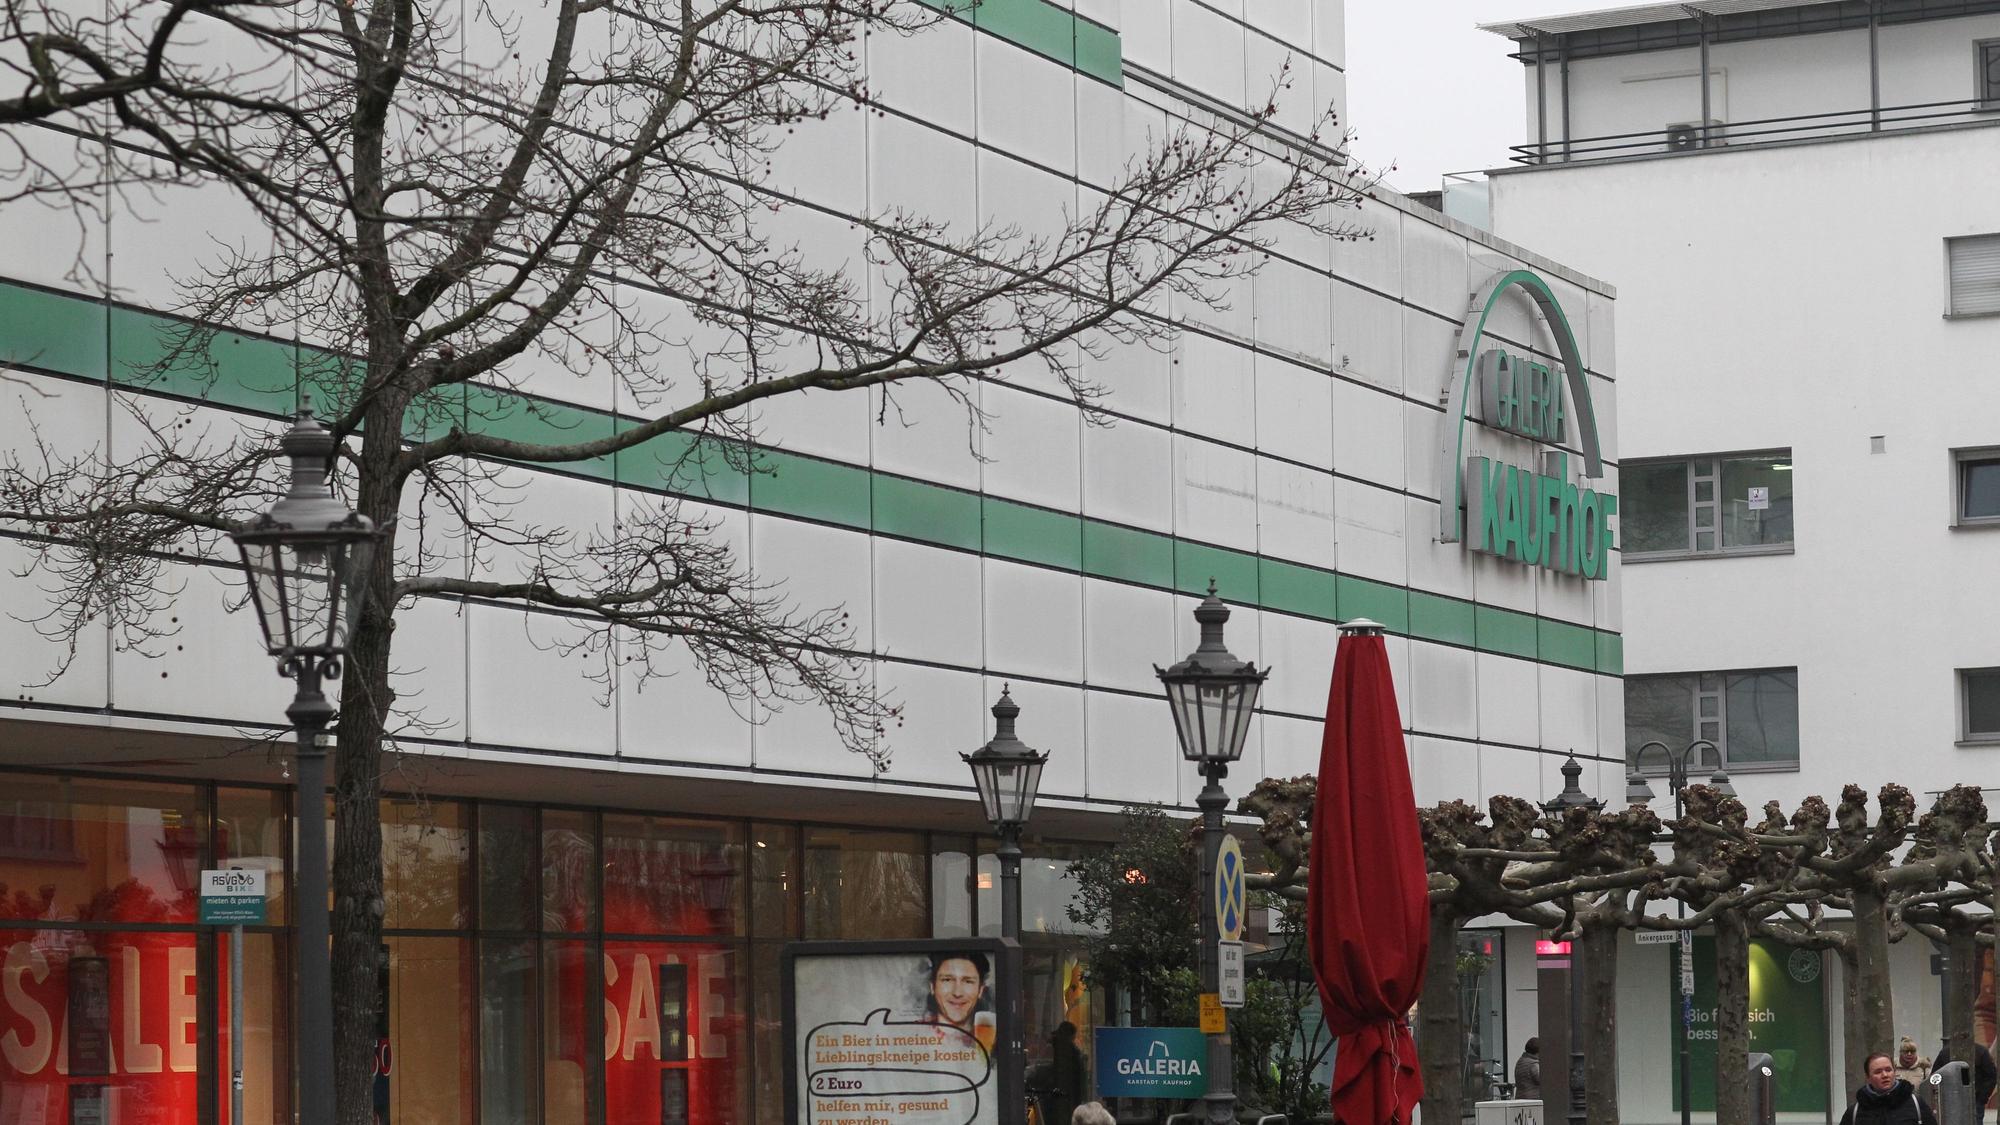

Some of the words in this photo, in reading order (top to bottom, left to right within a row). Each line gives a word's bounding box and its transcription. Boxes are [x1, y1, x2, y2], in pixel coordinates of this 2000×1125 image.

[212, 873, 238, 886] RSVG
[206, 897, 229, 905] mieten
[1638, 934, 1674, 943] Ankergasse
[0, 941, 197, 1075] SLE
[604, 953, 728, 1061] SAE
[1748, 1008, 1775, 1022] sich
[815, 1035, 839, 1047] Ein
[842, 1035, 872, 1047] Bier
[876, 1034, 890, 1046] in
[893, 1034, 944, 1046] meiner
[815, 1050, 930, 1066] Lieblingskneipe
[934, 1049, 977, 1062] kostet
[1117, 1058, 1202, 1076] GALERIA
[816, 1078, 824, 1090] 2
[828, 1077, 863, 1090] Euro
[816, 1100, 861, 1113] helfen
[864, 1100, 895, 1113] mir,
[898, 1098, 949, 1115] gesund
